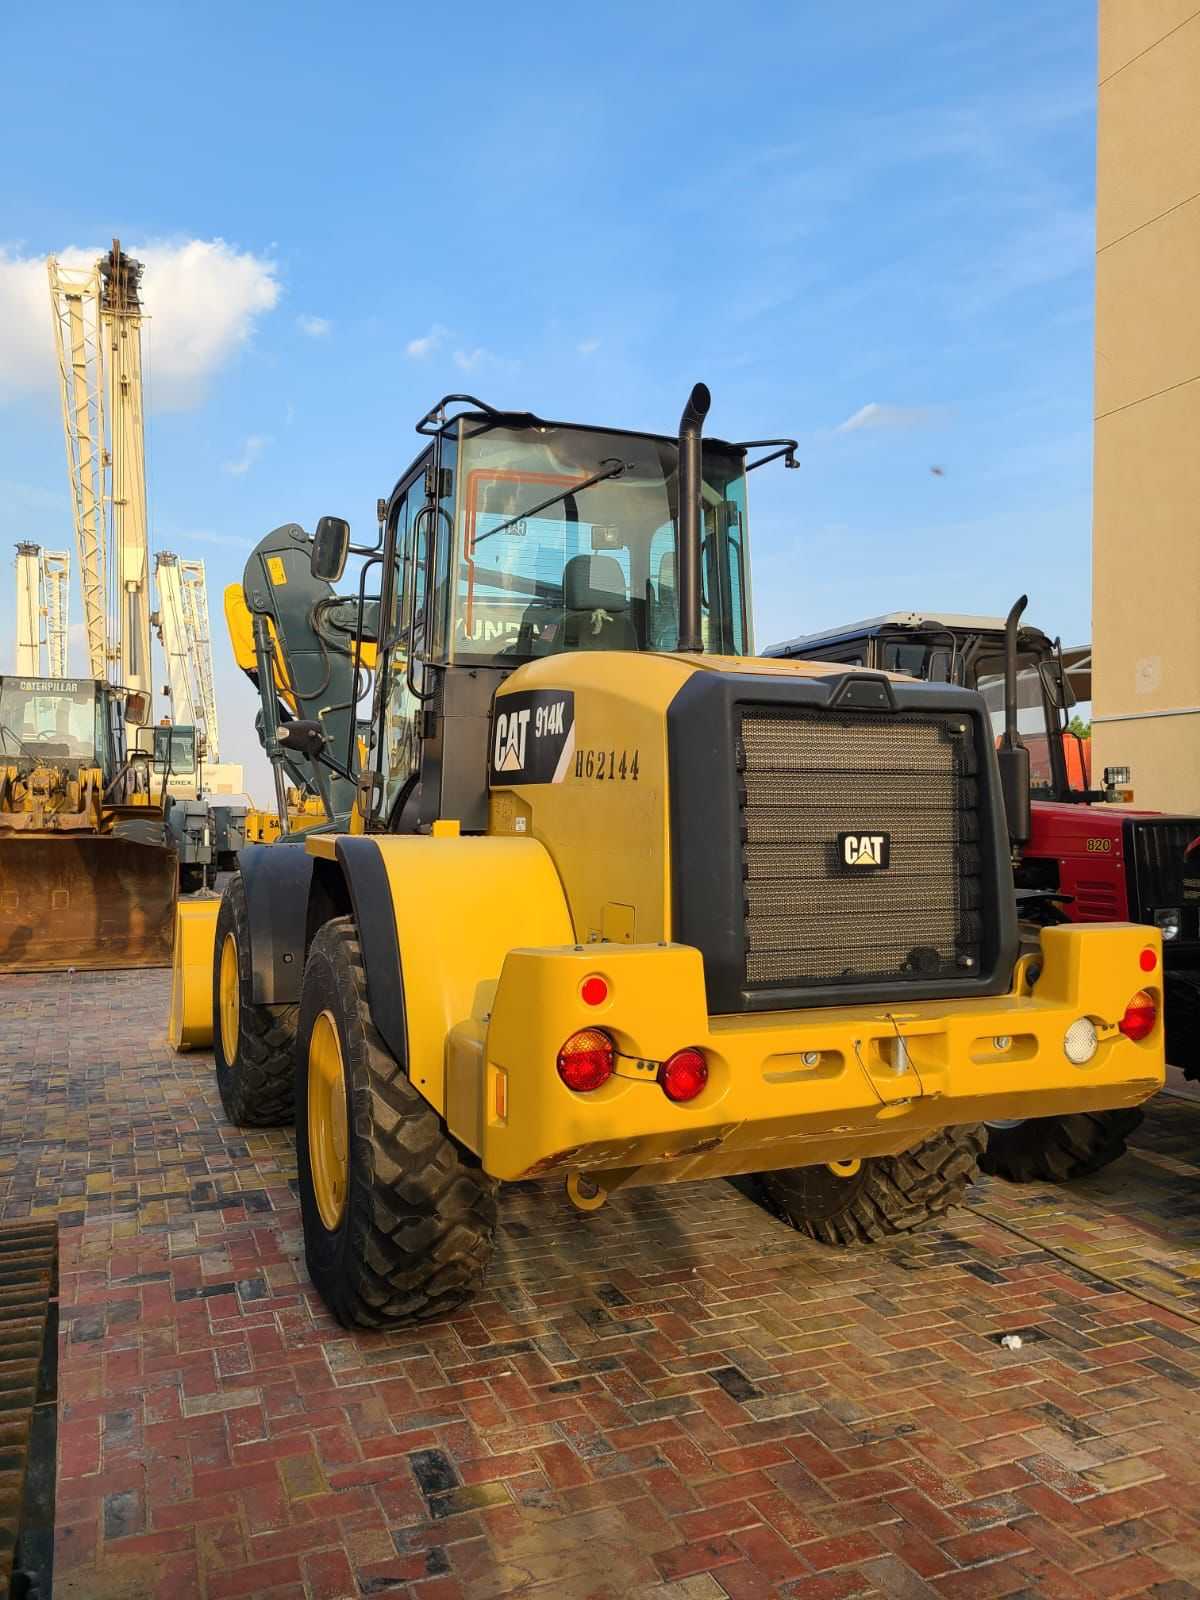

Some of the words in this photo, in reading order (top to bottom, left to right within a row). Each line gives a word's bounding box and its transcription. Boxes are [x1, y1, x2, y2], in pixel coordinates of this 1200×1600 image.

[20, 681, 78, 692] CATERPILLAR
[494, 709, 531, 772] CAT
[535, 701, 565, 738] 914K
[575, 749, 640, 780] H62144
[844, 836, 884, 865] CAT
[1087, 838, 1111, 852] 820
